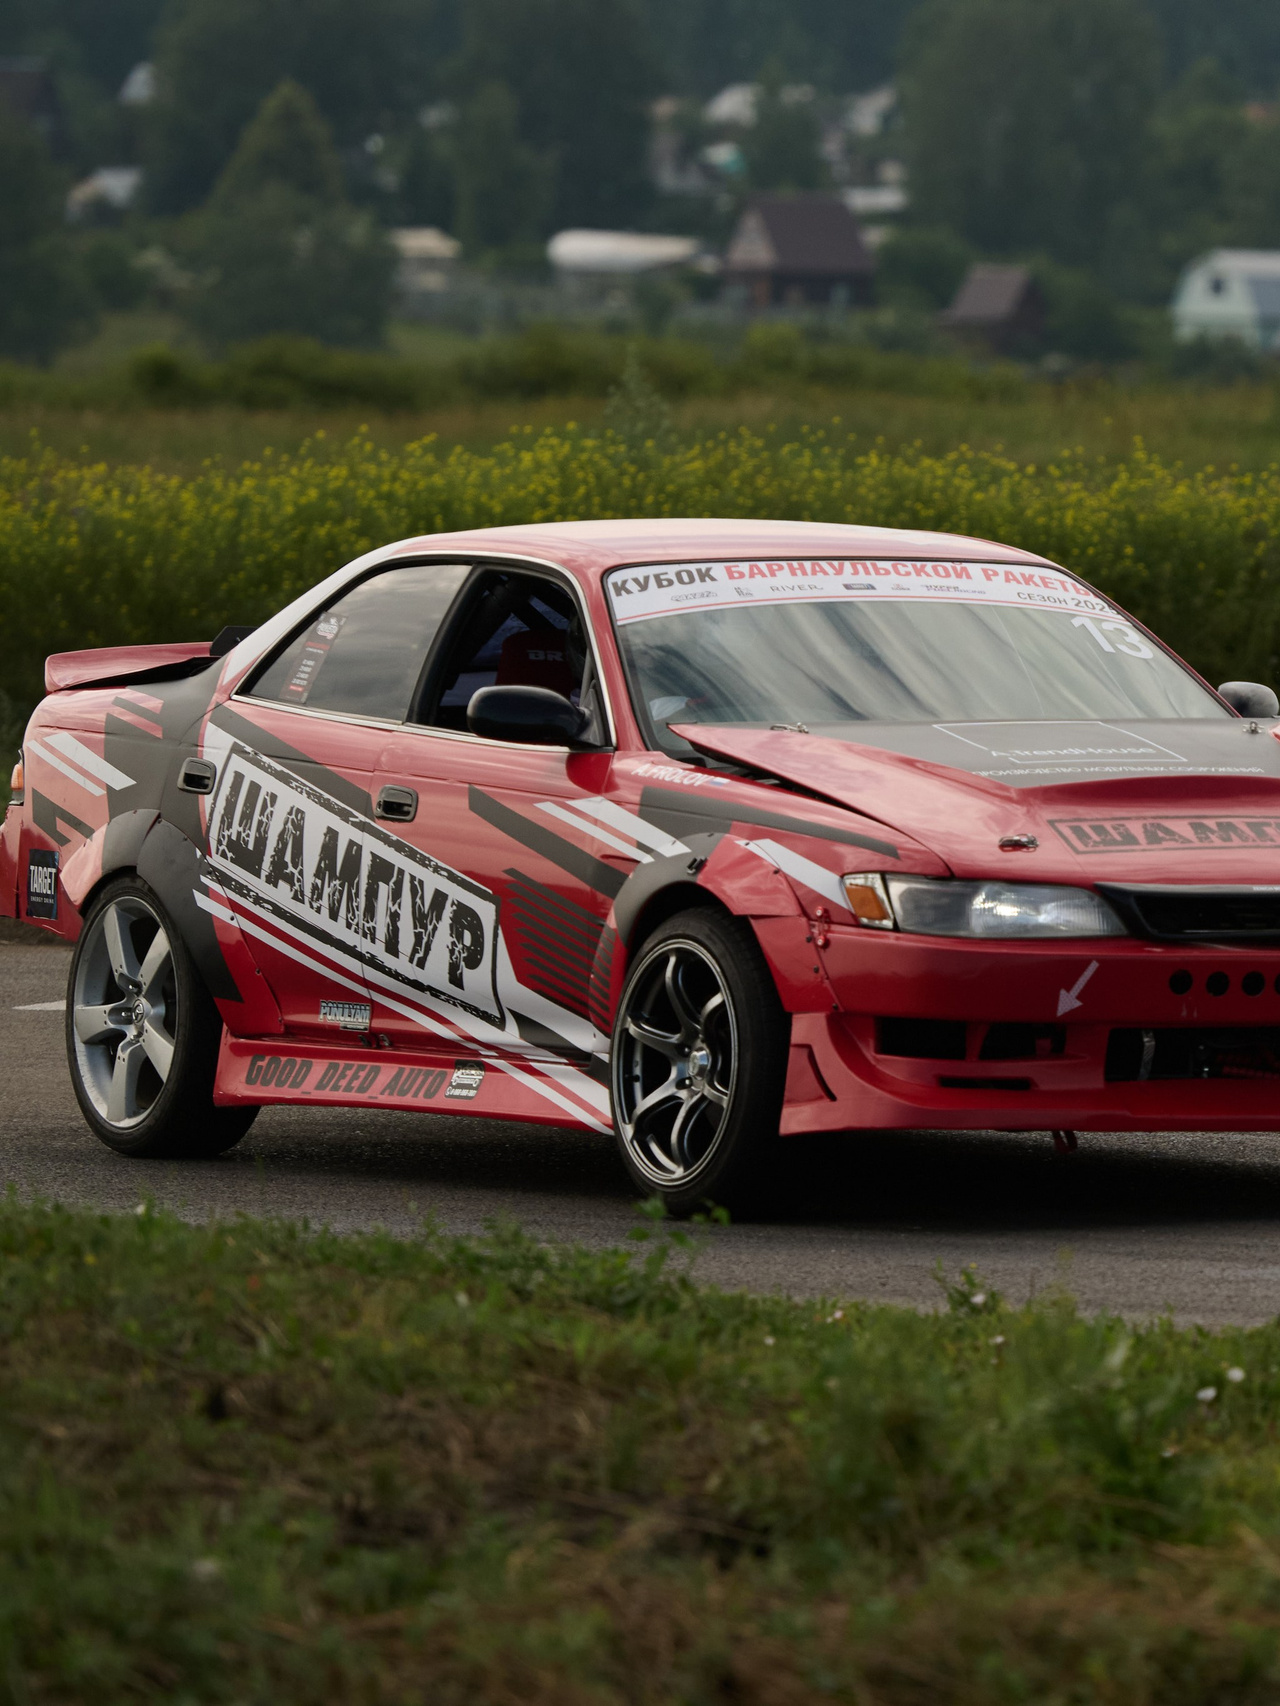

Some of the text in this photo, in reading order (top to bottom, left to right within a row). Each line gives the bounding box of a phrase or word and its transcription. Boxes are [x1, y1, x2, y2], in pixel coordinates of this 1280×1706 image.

[611, 566, 718, 597] КУБОК
[723, 561, 973, 581] БАРНАУЛЬСКОЙ
[1017, 591, 1068, 606] СЕЗОН
[1070, 616, 1154, 660] 13
[29, 865, 57, 895] TARGET
[216, 769, 485, 991] ШАМПУР
